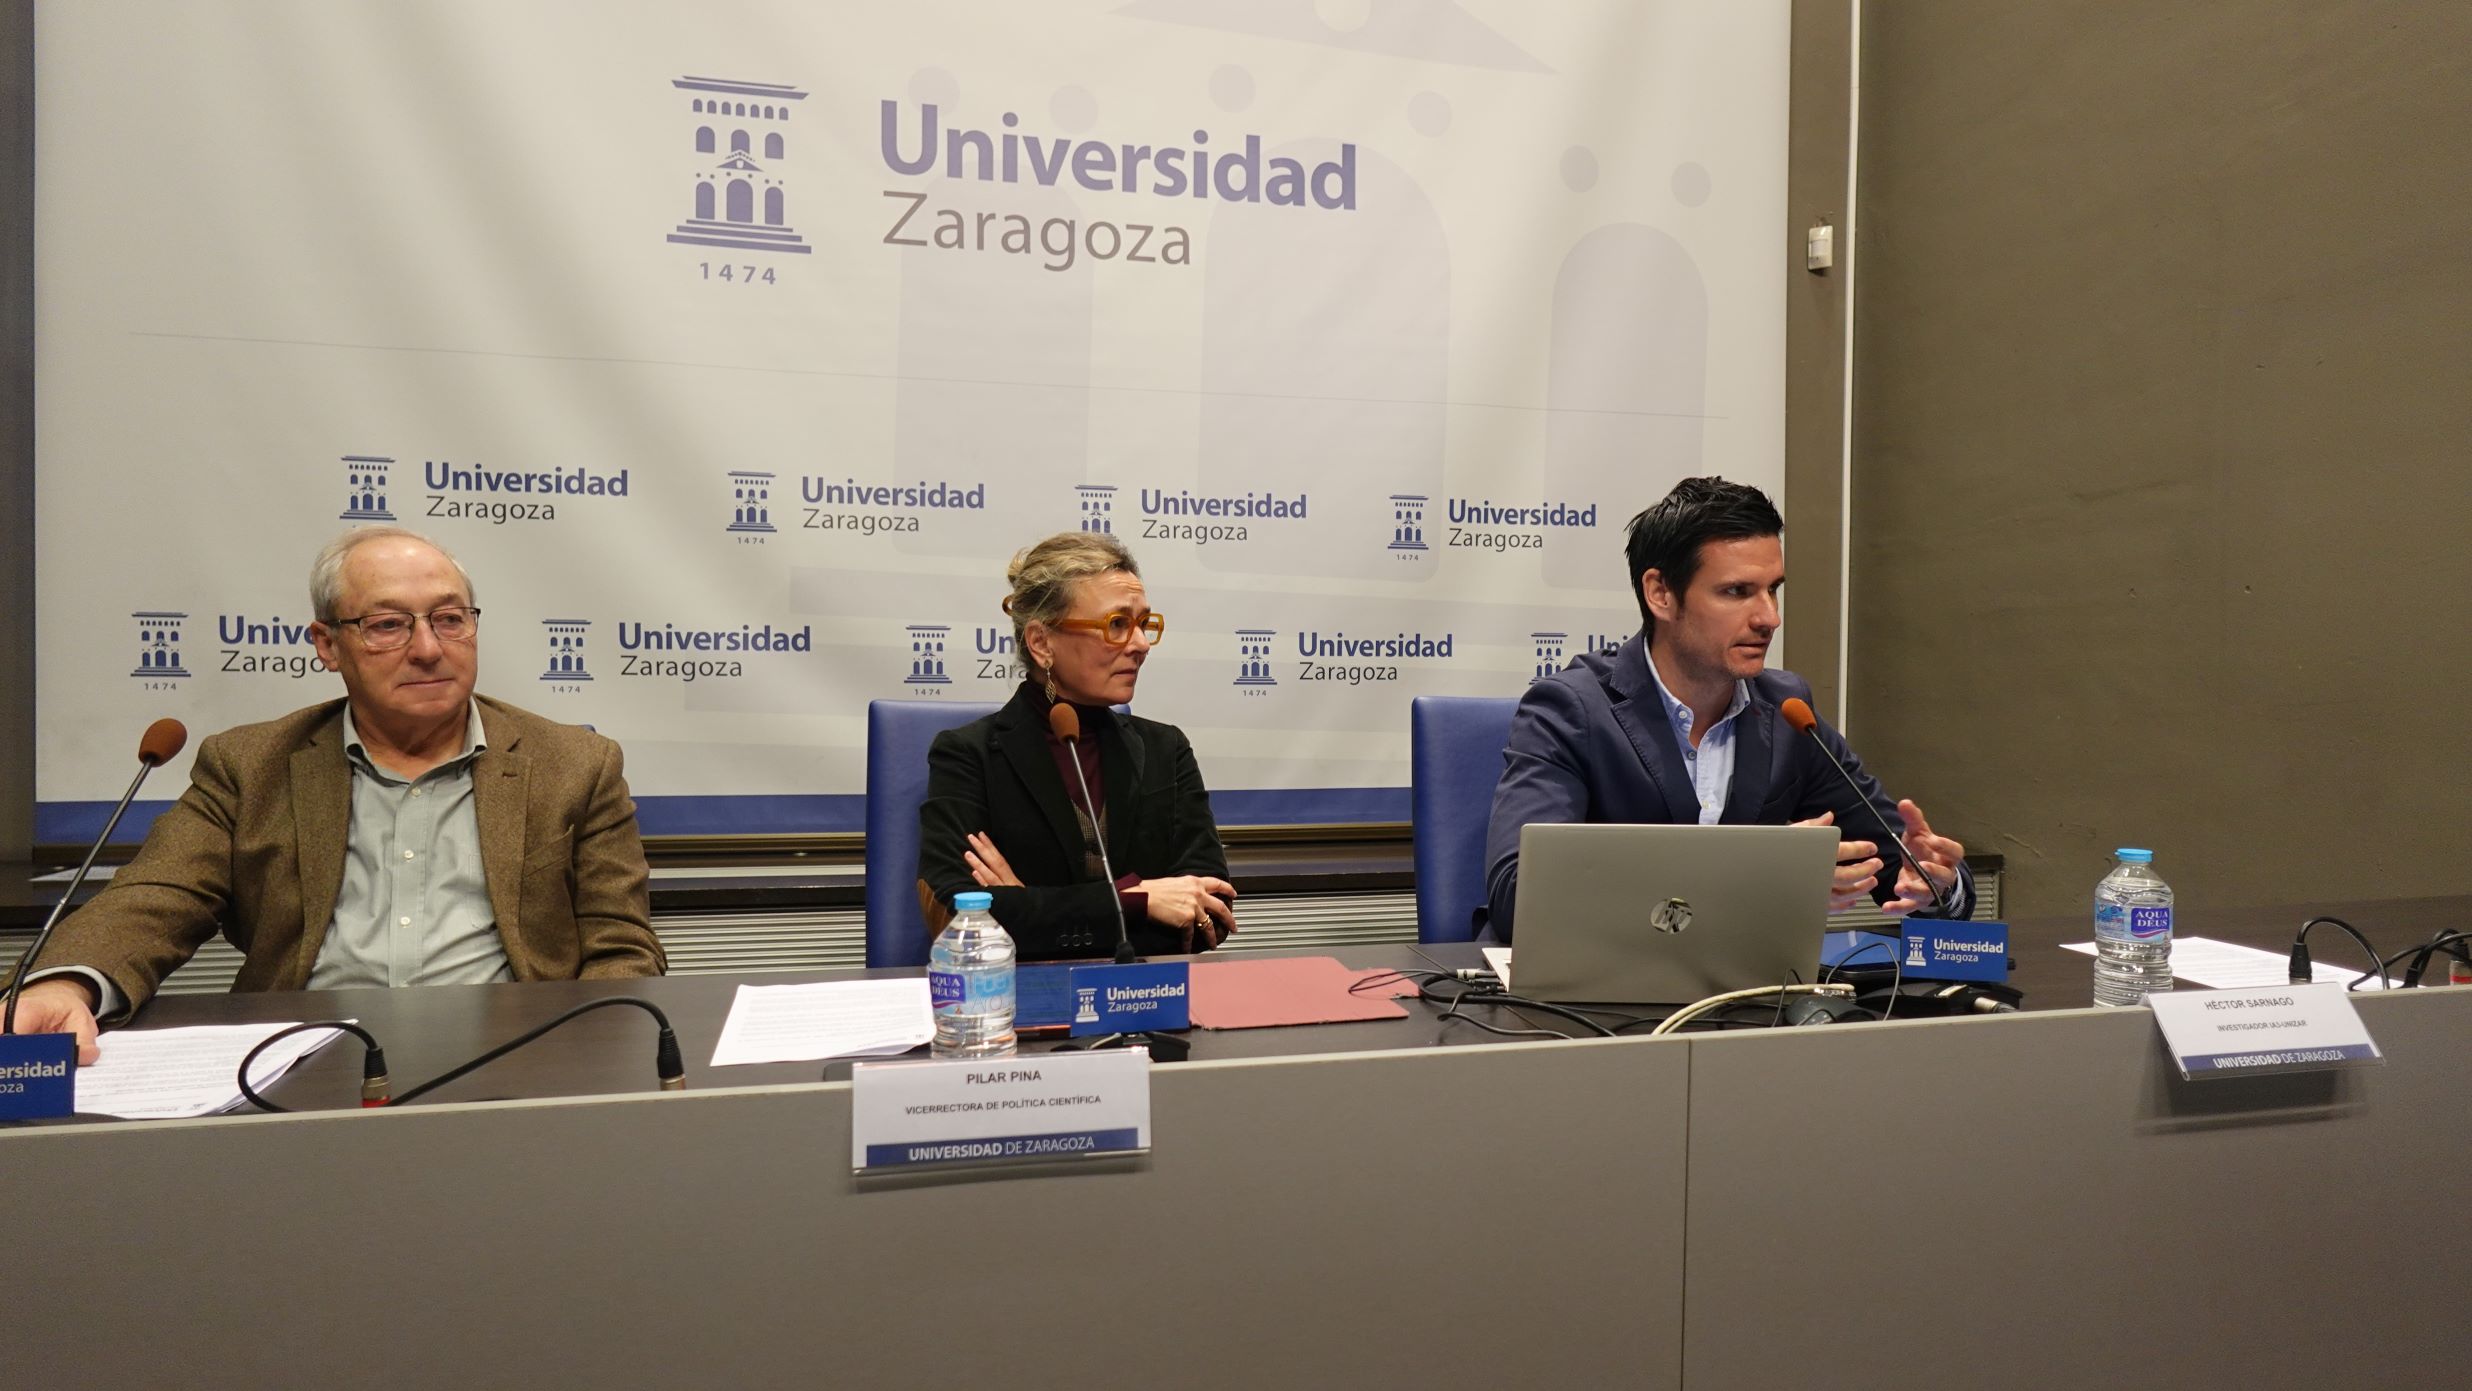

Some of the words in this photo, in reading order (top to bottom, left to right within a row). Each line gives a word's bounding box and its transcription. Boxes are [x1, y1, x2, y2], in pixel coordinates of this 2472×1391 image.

[880, 99, 1357, 211] Universidad
[883, 190, 1191, 273] Zaragoza
[699, 262, 777, 285] 1474
[425, 461, 628, 497] Universidad
[802, 476, 985, 509] Universidad
[1141, 488, 1308, 519] Universidad
[426, 495, 555, 525] Zaragoza
[1448, 498, 1597, 527] Universidad
[802, 508, 919, 536] Zaragoza
[1142, 519, 1248, 545] Zaragoza
[737, 536, 766, 545] 1474
[1448, 527, 1543, 553] Zaragoza
[618, 621, 811, 652] Universidad
[1298, 631, 1453, 658] Universidad
[620, 655, 742, 683] Zaragoza
[1299, 661, 1398, 686] Zaragoza
[144, 682, 177, 691] 1474
[550, 685, 581, 694] 1474
[914, 688, 941, 696] 1474
[1242, 689, 1267, 697] 1474
[2135, 910, 2168, 920] AQUA
[2137, 919, 2168, 927] DEUS
[1933, 938, 2004, 954] Universidad
[1934, 951, 1979, 963] Zaragoza
[1107, 983, 1185, 1001] Universidad
[2245, 996, 2295, 1008] SARNAGO
[1107, 1001, 1158, 1013] Zaragoza
[2216, 1022, 2269, 1032] INVESTIGADOR
[2212, 1054, 2282, 1069] UNIVERSIDAD
[2280, 1053, 2297, 1063] DE
[2296, 1049, 2346, 1063] ZARAGOZA
[966, 1072, 1007, 1085] PILAR
[1010, 1070, 1042, 1083] PINA
[905, 1102, 984, 1116] VICERRECTORA
[986, 1101, 999, 1111] DE
[1001, 1096, 1046, 1110] POLÍTICA
[1048, 1094, 1102, 1107] CIENTÍFICA
[908, 1143, 1003, 1161] UNIVERSIDAD
[1005, 1141, 1023, 1154] DE
[1024, 1136, 1095, 1153] ZARAGOZA
